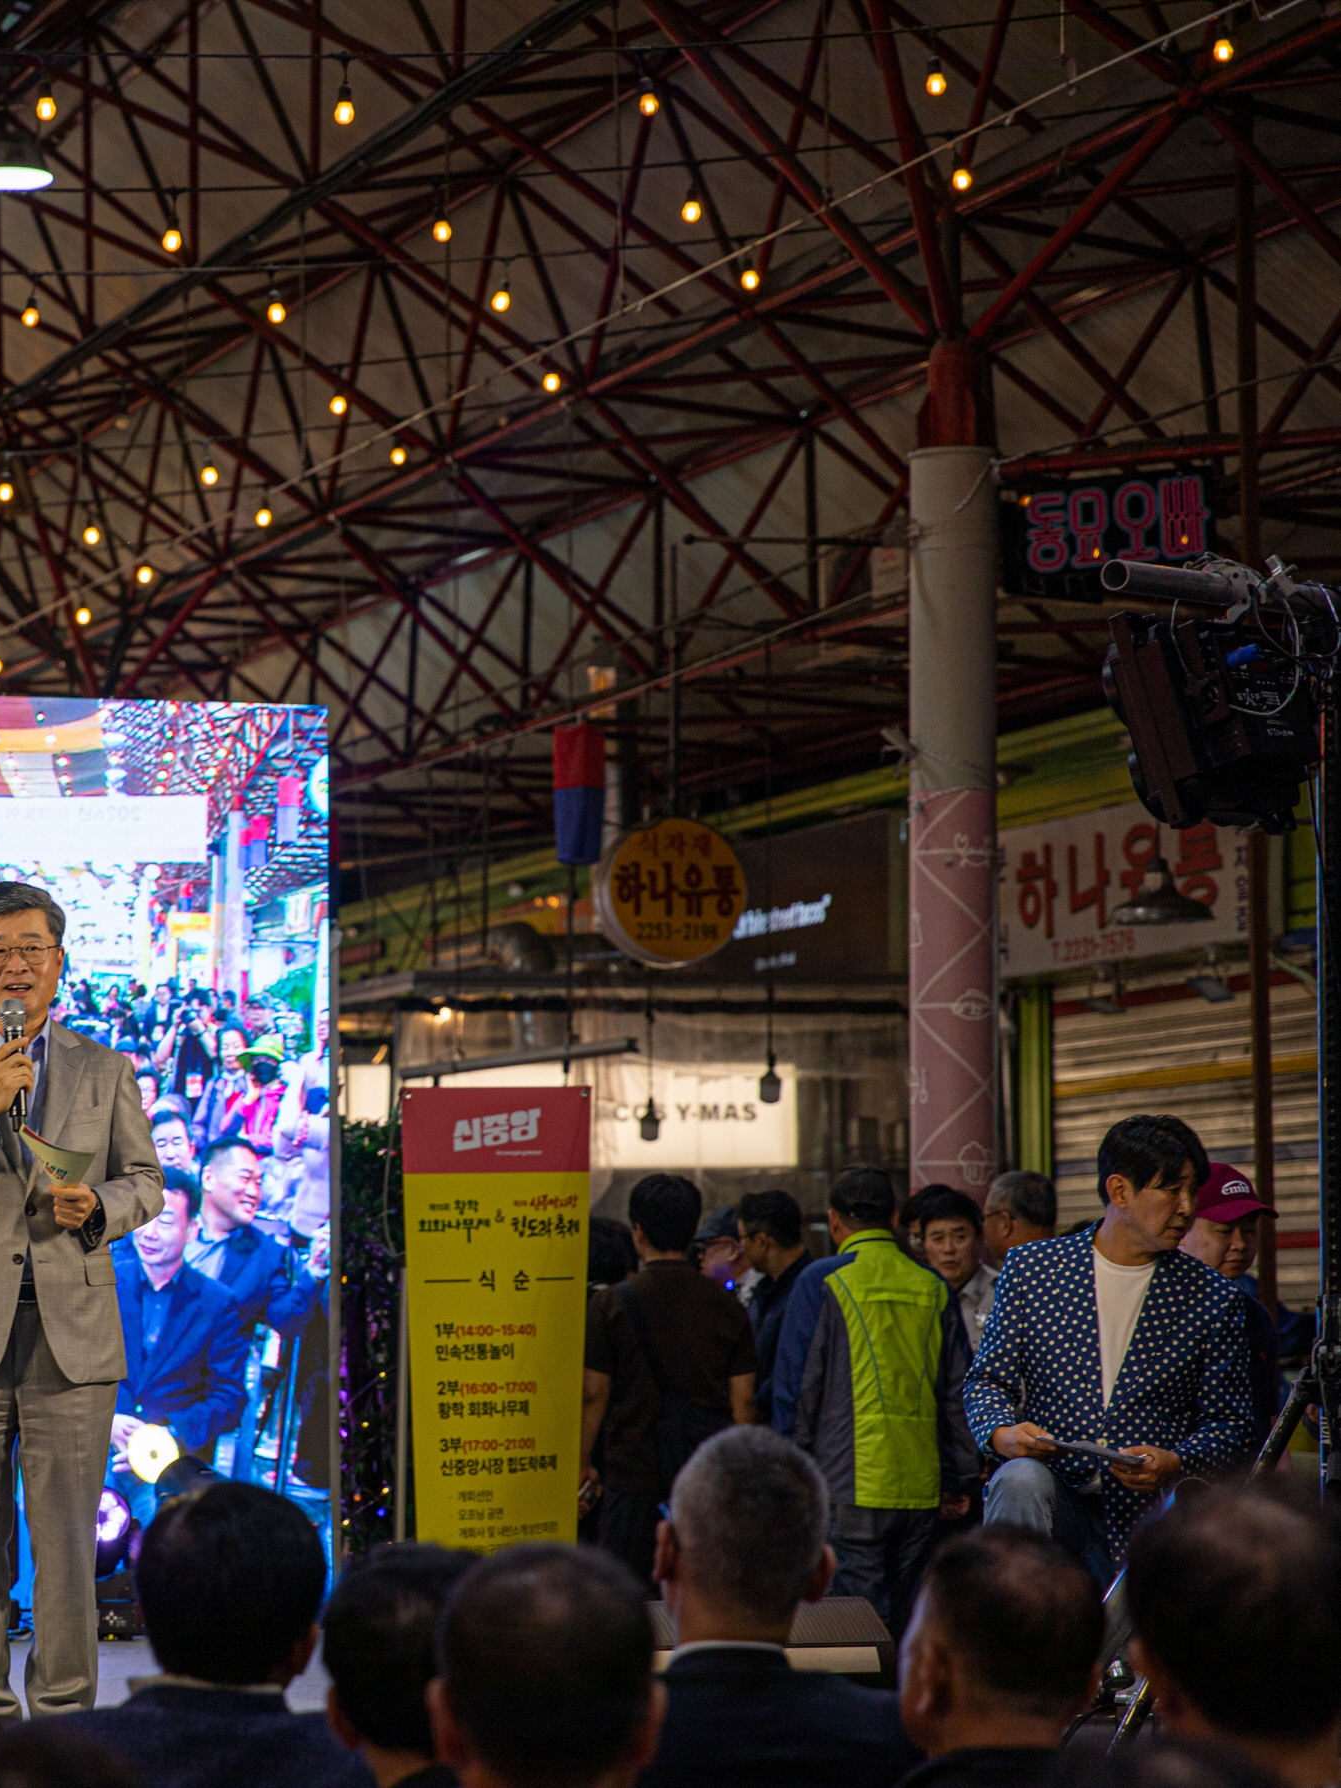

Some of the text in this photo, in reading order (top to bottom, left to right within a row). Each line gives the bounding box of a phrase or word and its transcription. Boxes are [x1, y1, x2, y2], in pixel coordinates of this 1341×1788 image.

[614, 862, 740, 916] 하나유통
[1015, 819, 1223, 939] 하나유통
[676, 1102, 758, 1122] Y-MAS
[453, 1107, 541, 1151] 신중앙
[418, 1217, 491, 1243] 회화나무제
[435, 1343, 515, 1361] 민속전통놀이
[438, 1400, 530, 1419] 황학 회화나무제
[440, 1458, 504, 1477] 신중앙시장
